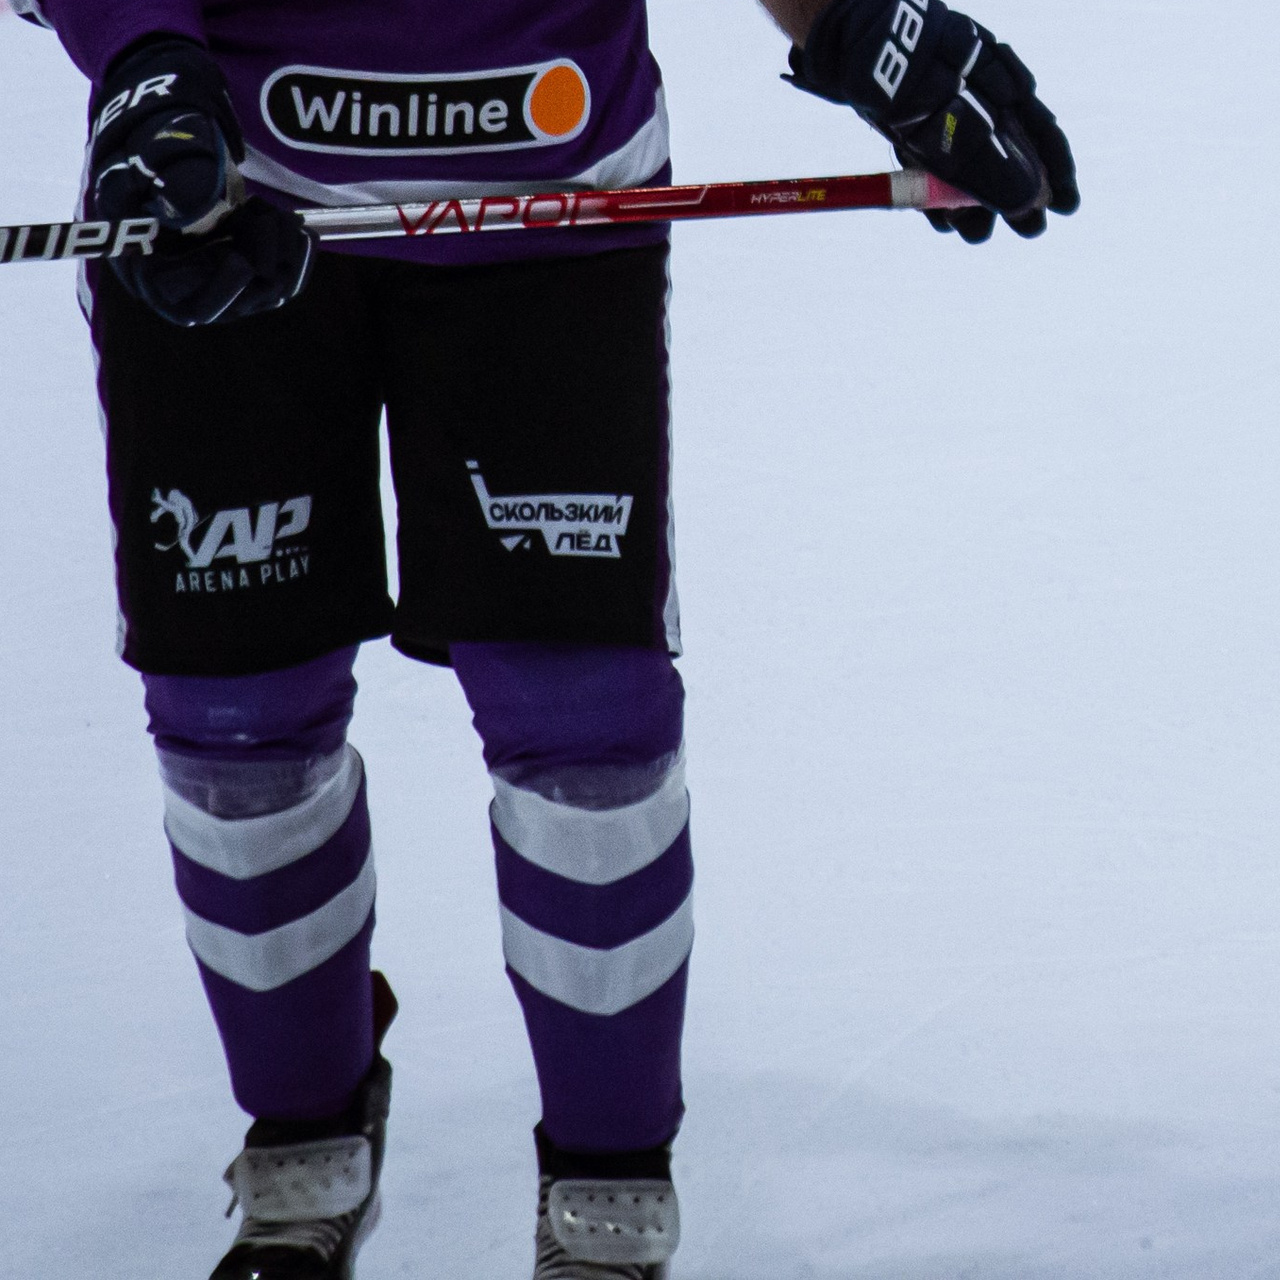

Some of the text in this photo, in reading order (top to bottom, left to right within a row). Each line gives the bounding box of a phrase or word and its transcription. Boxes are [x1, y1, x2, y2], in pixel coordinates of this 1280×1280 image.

[290, 85, 509, 139] Winline
[489, 495, 625, 525] СКОЛЬЗКИЙ
[554, 528, 613, 553] ЛЁД
[175, 555, 310, 593] ARENA PLAY
